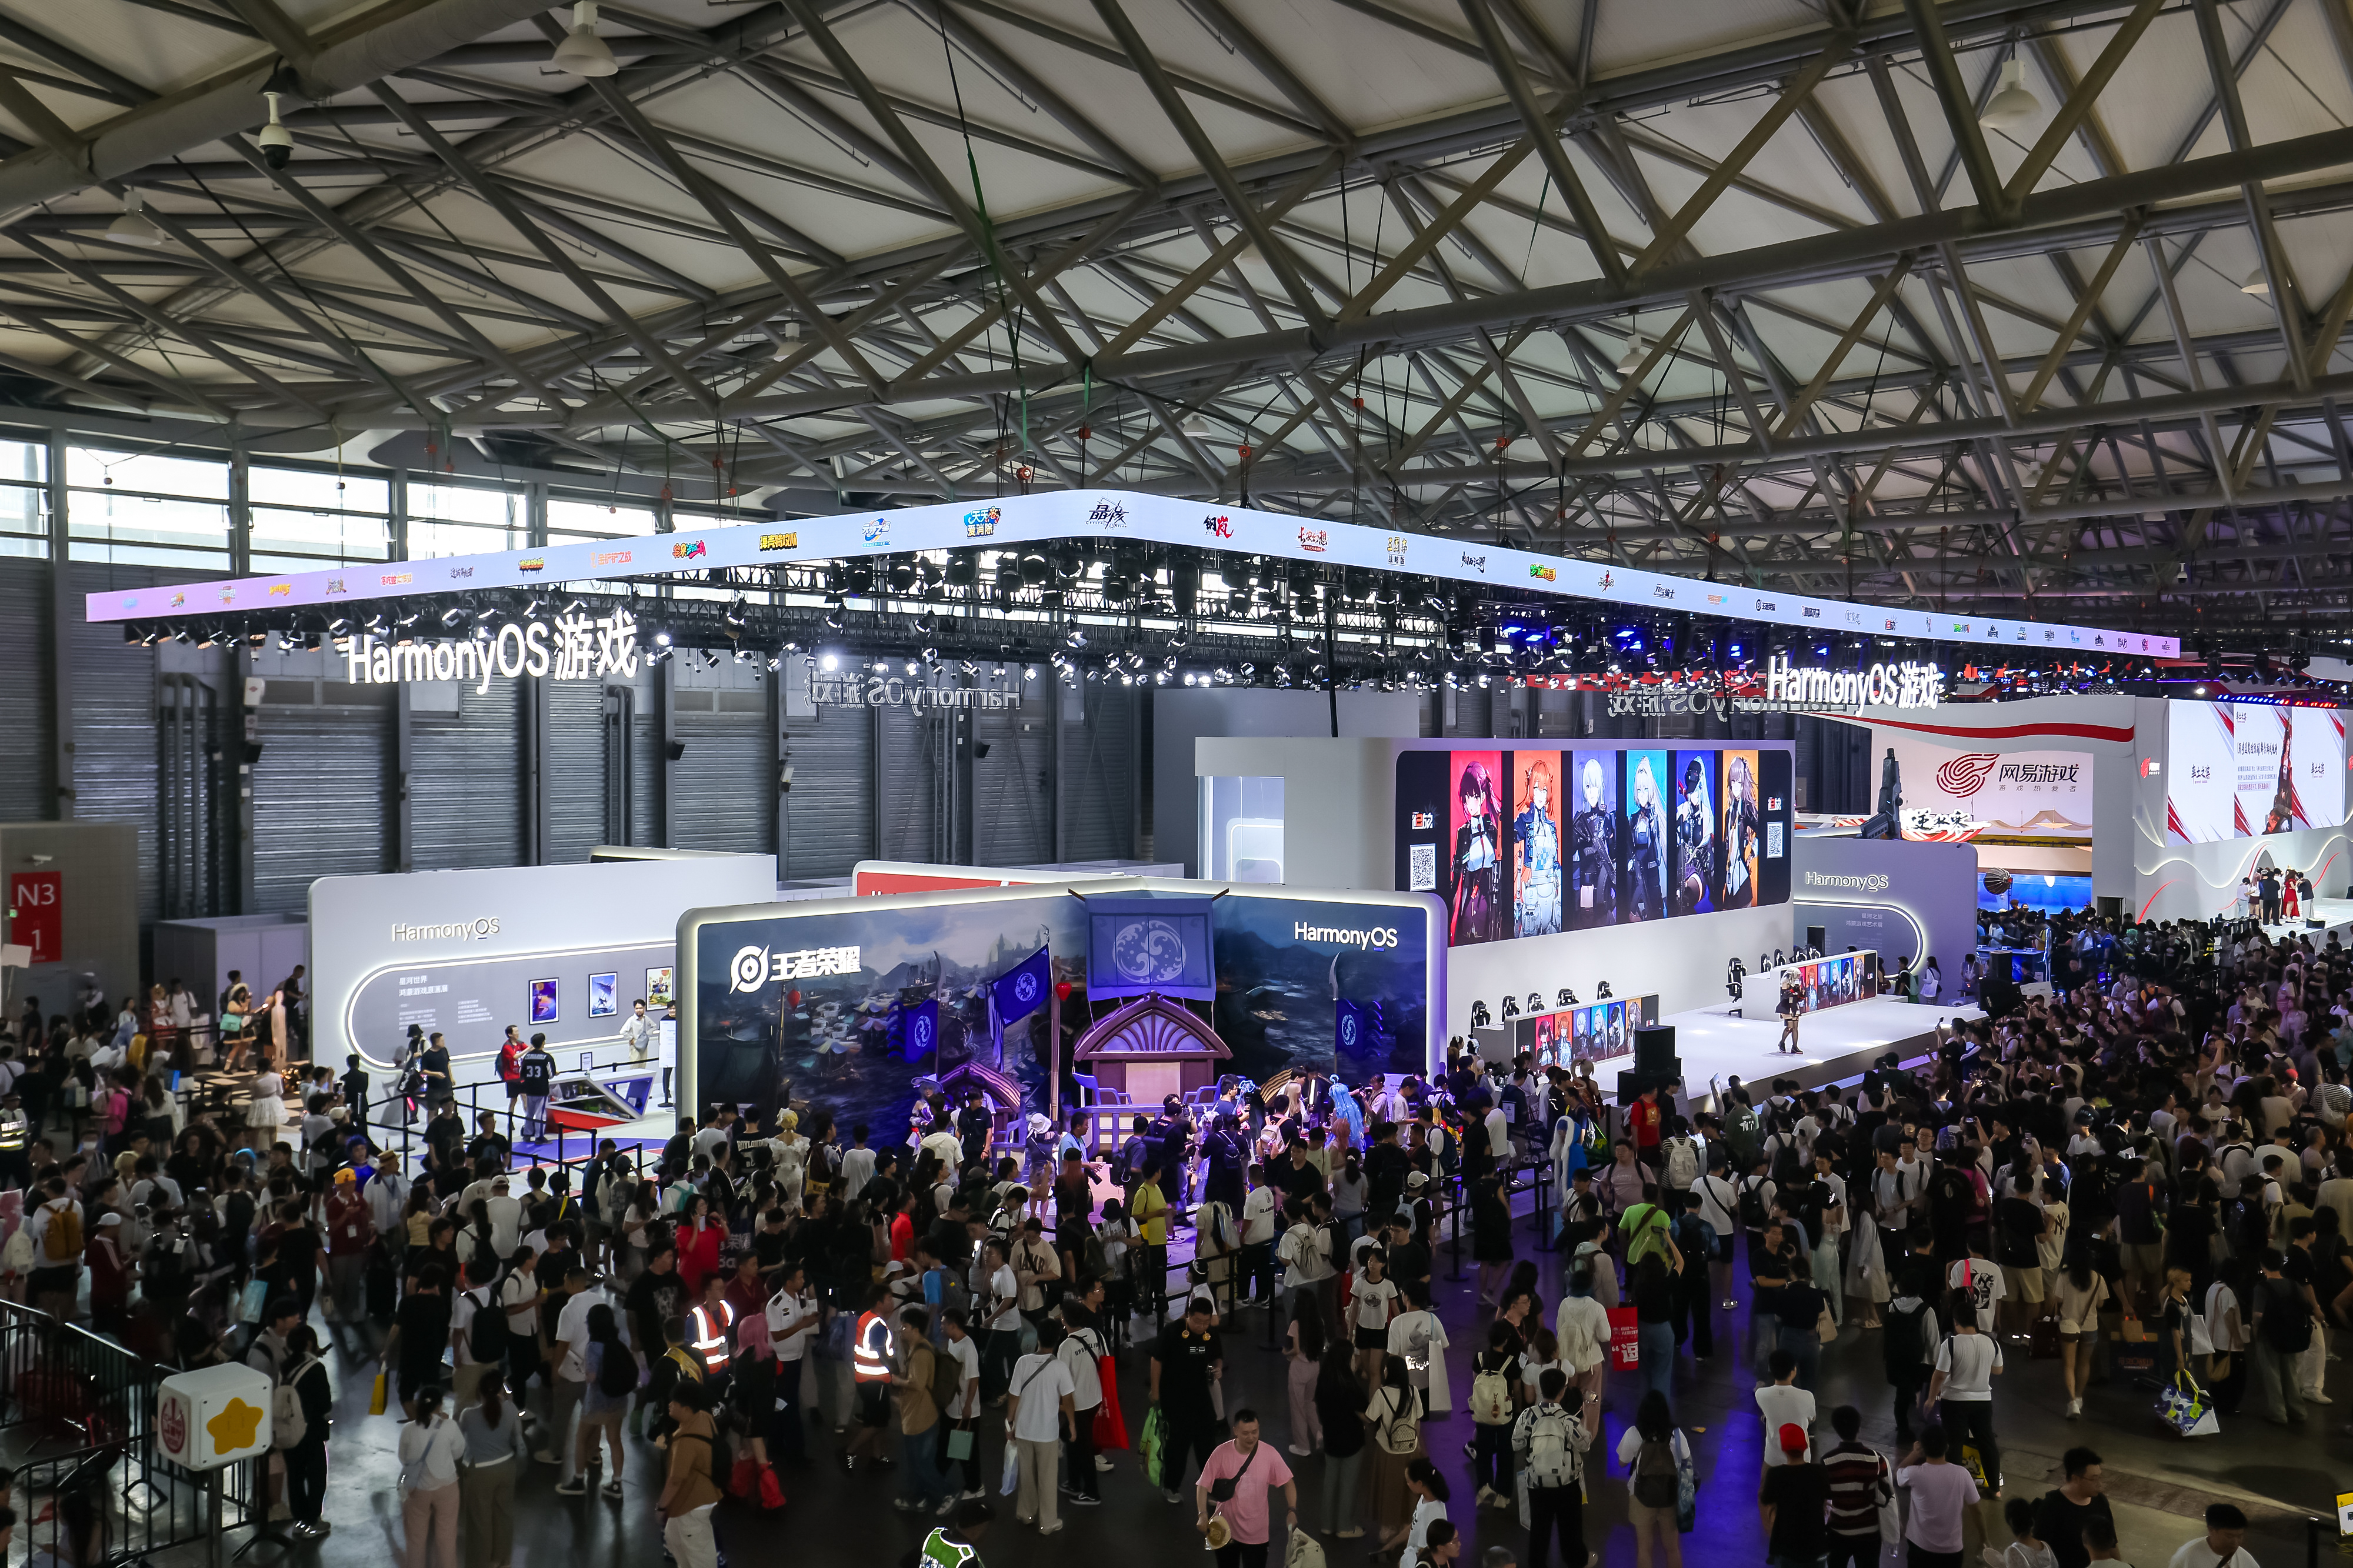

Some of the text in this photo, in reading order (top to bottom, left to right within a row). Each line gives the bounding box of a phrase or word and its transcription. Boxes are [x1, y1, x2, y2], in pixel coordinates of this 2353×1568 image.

[967, 524, 993, 537] 爱消除
[759, 532, 797, 551] 弹壳特攻队
[1999, 763, 2079, 783] 网易游戏
[1805, 872, 1889, 892] HarmonyOS
[18, 884, 55, 906] N3
[32, 929, 41, 950] 1
[392, 917, 500, 942] HarmonyOS
[1295, 921, 1398, 950] HarmonyOS
[769, 945, 862, 982] 王者荣耀
[399, 975, 428, 986] 星河世界
[399, 985, 449, 997] 鸿蒙游戏原画展
[526, 1065, 541, 1078] 33
